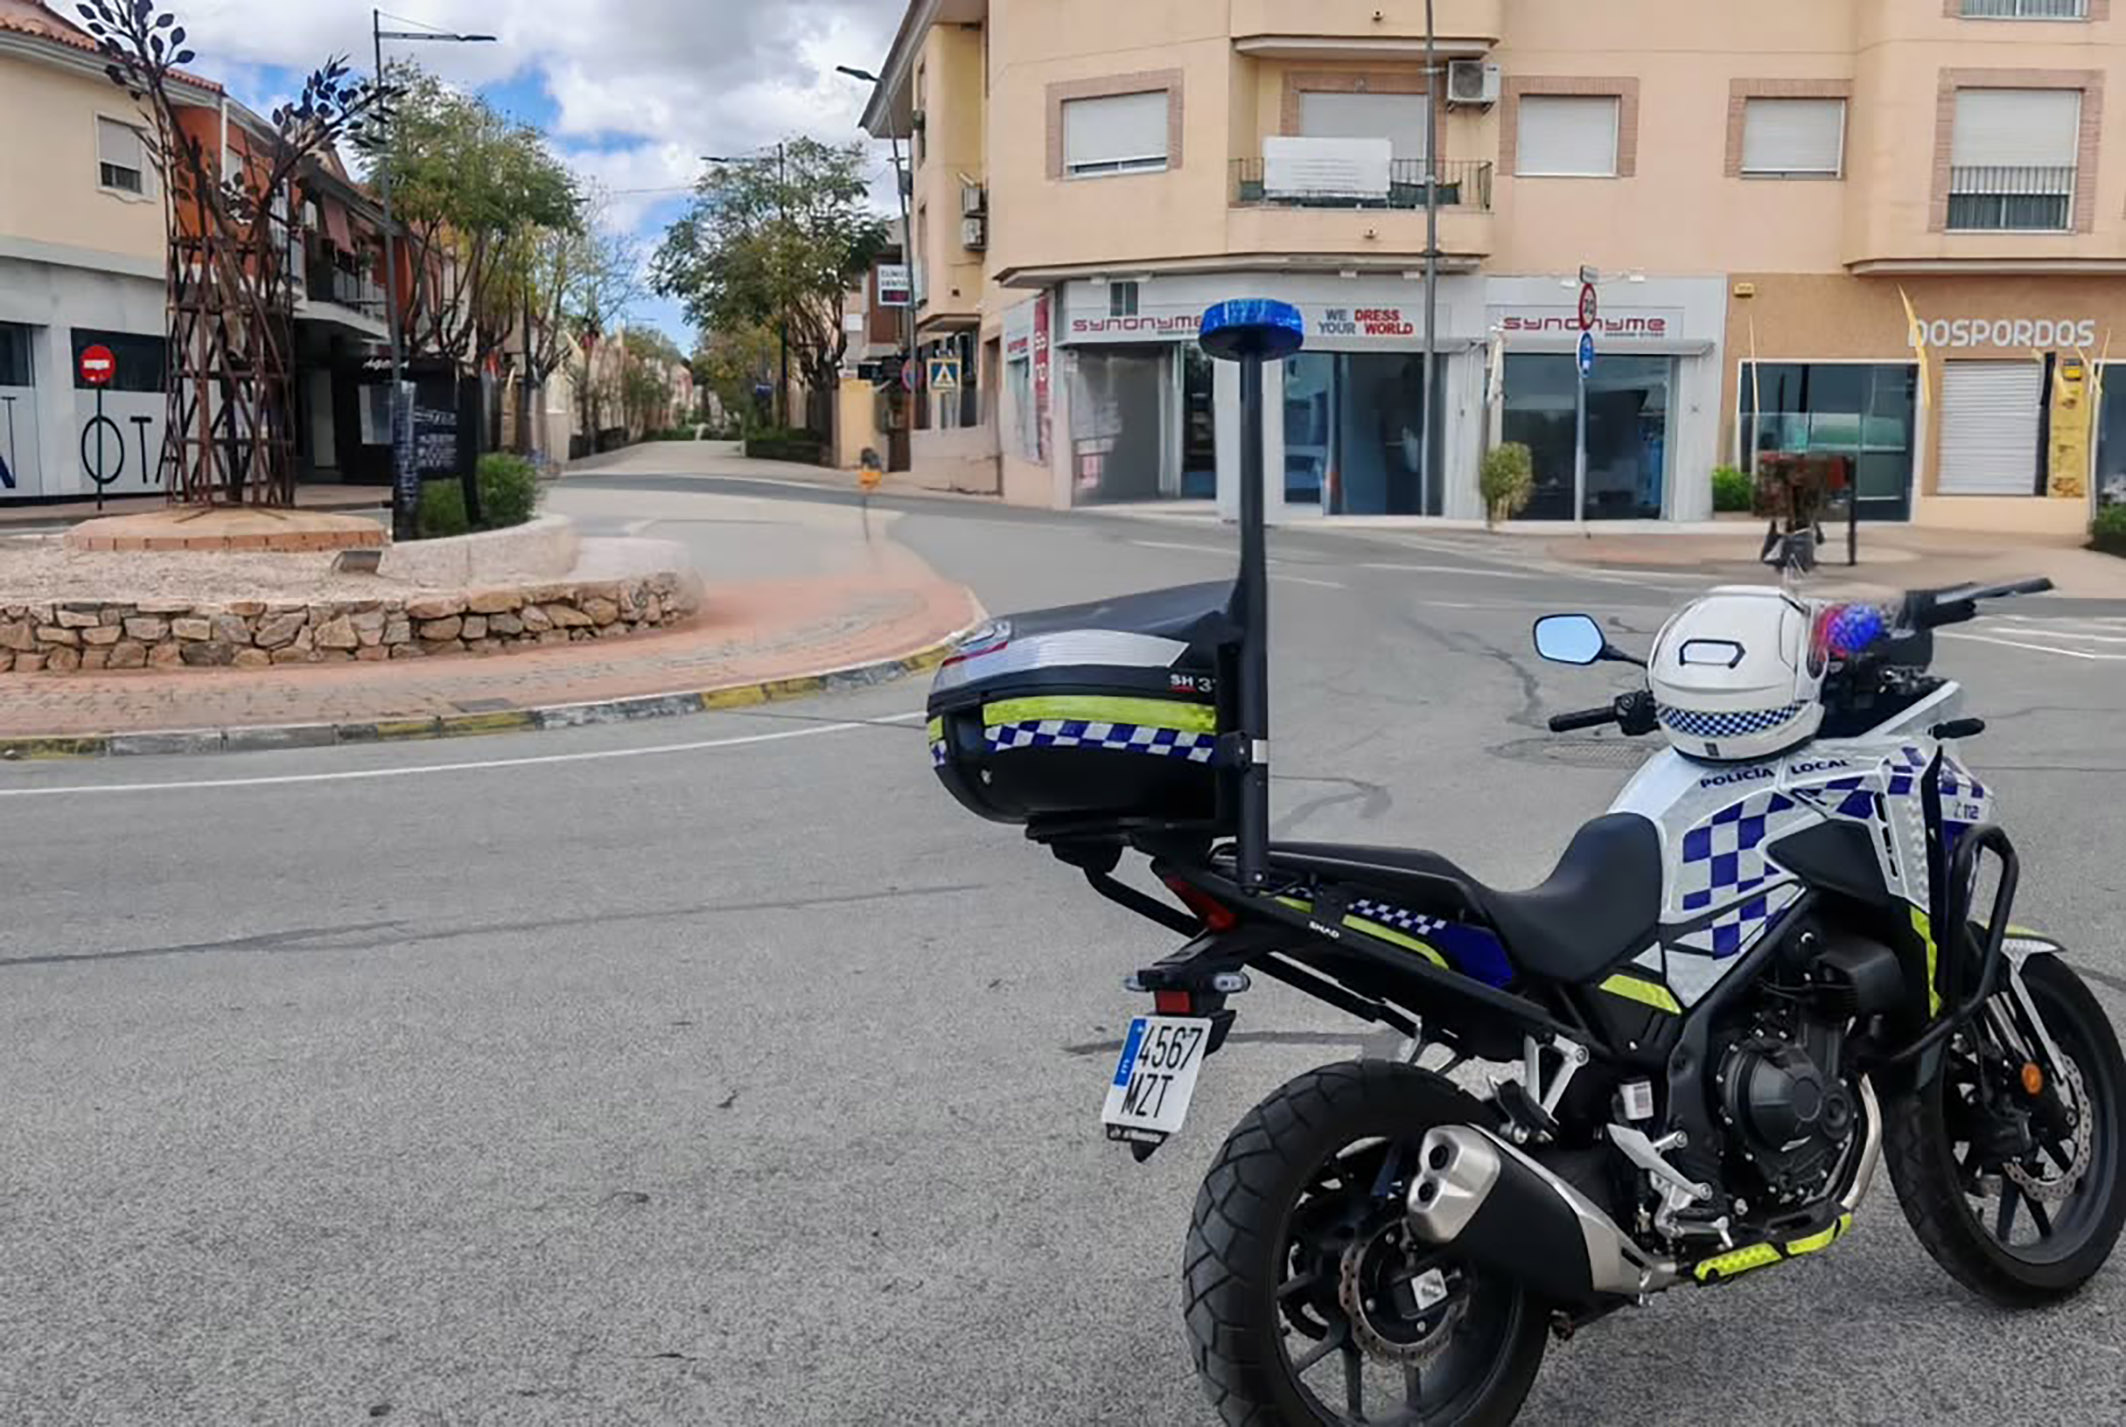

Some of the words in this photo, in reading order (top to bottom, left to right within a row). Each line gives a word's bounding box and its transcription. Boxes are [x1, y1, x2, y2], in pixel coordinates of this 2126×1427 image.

[1318, 322, 1356, 335] YOUR
[1365, 322, 1414, 335] WORLD
[1325, 308, 1347, 321] WE
[1354, 308, 1400, 321] DRESS
[1908, 317, 2096, 347] DOSPORDOS
[1170, 673, 1194, 687] SH
[1198, 676, 1217, 693] 3
[1700, 767, 1775, 788] POLICÍA
[1790, 759, 1849, 775] LOCAL
[1138, 1025, 1203, 1071] 4567
[1121, 1072, 1174, 1118] MZT
